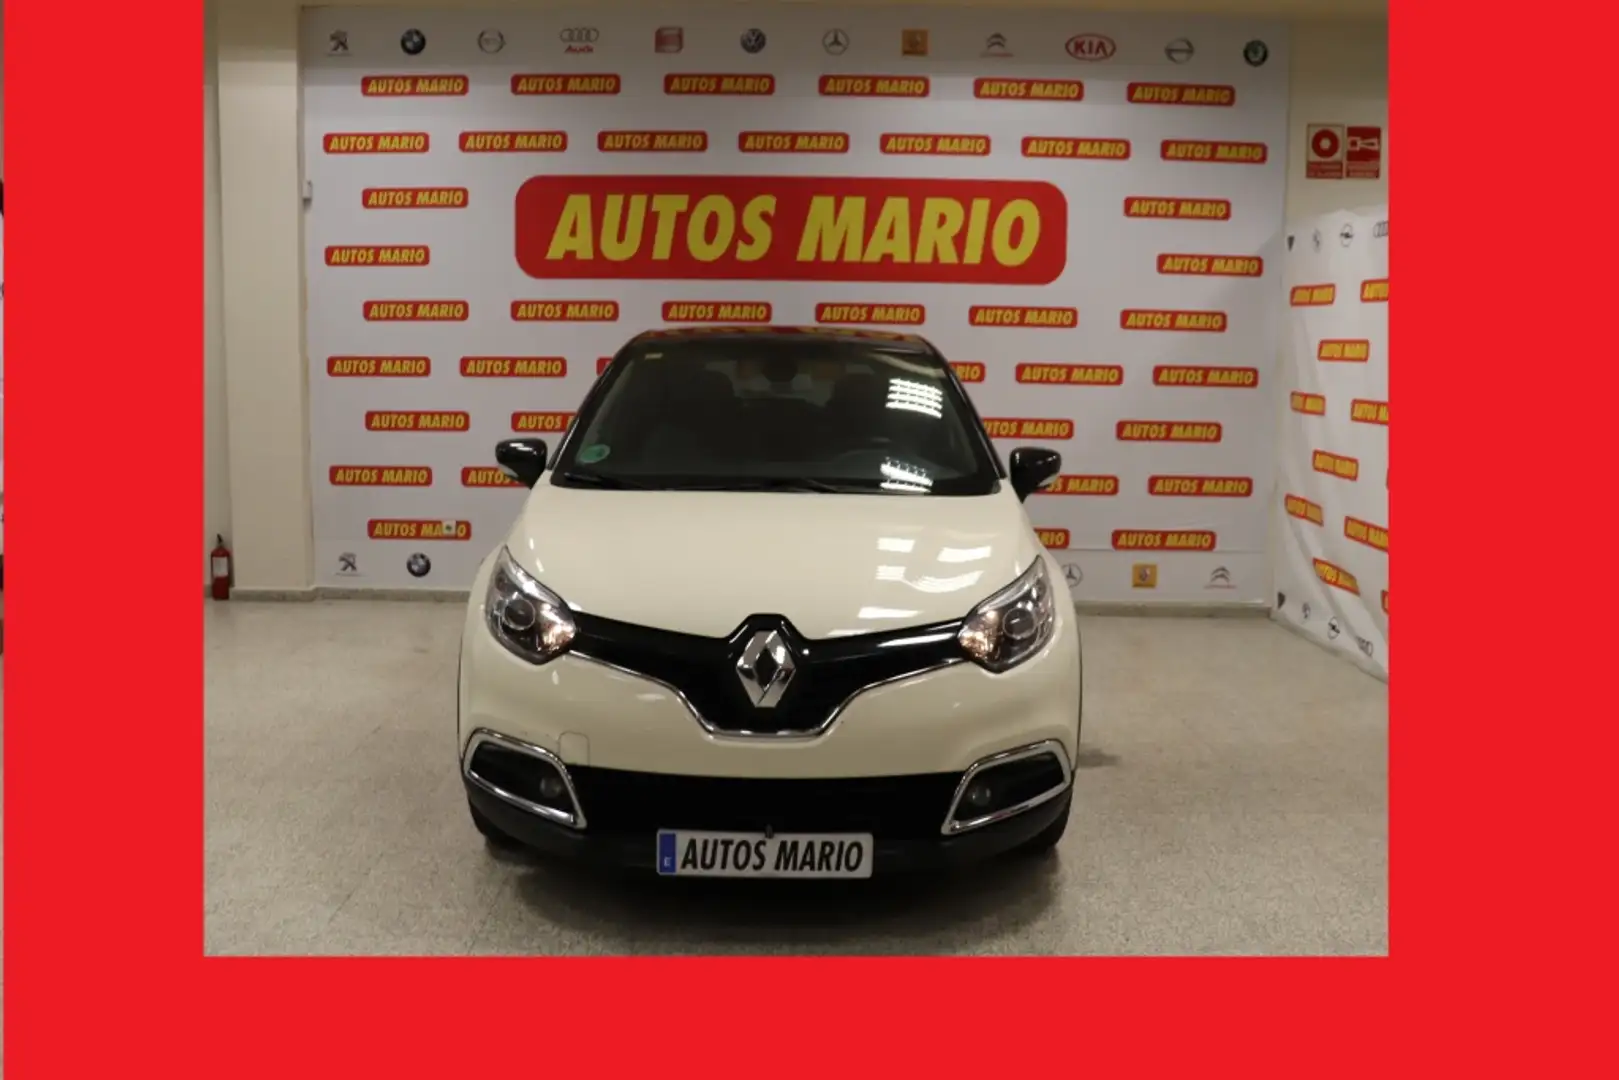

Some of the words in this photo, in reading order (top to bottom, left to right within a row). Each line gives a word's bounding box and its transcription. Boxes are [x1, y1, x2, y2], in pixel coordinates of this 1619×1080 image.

[1074, 40, 1108, 56] KIA
[368, 79, 412, 94] AUTOS
[416, 78, 463, 94] MARIO
[518, 77, 562, 91] AUTOS
[568, 77, 614, 91] MARIO
[671, 77, 715, 91] AUTOS
[722, 77, 769, 91] MARIO
[826, 78, 870, 93] AUTOS
[876, 79, 925, 94] MARIO
[980, 82, 1026, 98] AUTOS
[1030, 80, 1078, 98] MARIO
[1133, 86, 1177, 100] AUTOS
[1182, 87, 1229, 101] MARIO
[330, 136, 373, 151] AUTOS
[378, 135, 424, 151] MARIO
[466, 133, 509, 150] AUTOS
[515, 134, 562, 149] MARIO
[605, 134, 648, 148] AUTOS
[654, 134, 702, 148] MARIO
[745, 135, 790, 149] AUTOS
[796, 136, 844, 150] MARIO
[886, 137, 932, 153] AUTOS
[937, 136, 985, 153] MARIO
[1028, 140, 1073, 158] AUTOS
[1078, 139, 1125, 158] MARIO
[1168, 144, 1211, 161] AUTOS
[1216, 144, 1262, 159] MARIO
[368, 191, 412, 206] AUTOS
[417, 190, 463, 206] MARIO
[1131, 199, 1175, 218] AUTOS
[1179, 199, 1226, 218] MARIO
[546, 195, 776, 262] AUTOS
[797, 197, 1040, 267] MARIO
[332, 248, 374, 264] AUTOS
[379, 248, 424, 264] MARIO
[1163, 257, 1208, 274] AUTOS
[1212, 256, 1258, 273] MARIO
[370, 304, 412, 318] AUTOS
[417, 304, 464, 319] MARIO
[518, 304, 561, 318] AUTOS
[567, 304, 613, 318] MARIO
[669, 304, 713, 319] AUTOS
[718, 304, 766, 319] MARIO
[823, 307, 867, 323] AUTOS
[872, 307, 920, 323] MARIO
[976, 309, 1020, 326] AUTOS
[1025, 308, 1073, 325] MARIO
[1127, 312, 1170, 330] AUTOS
[1175, 312, 1222, 328] MARIO
[334, 360, 375, 374] AUTOS
[380, 360, 425, 374] MARIO
[467, 360, 510, 374] AUTOS
[515, 360, 561, 374] MARIO
[1022, 366, 1066, 383] AUTOS
[1071, 366, 1118, 382] MARIO
[1159, 369, 1203, 383] AUTOS
[1208, 368, 1253, 384] MARIO
[372, 414, 413, 428] AUTOS
[419, 414, 464, 428] MARIO
[518, 416, 562, 430] AUTOS
[1021, 422, 1069, 437] MARIO
[1123, 424, 1166, 438] AUTOS
[1171, 423, 1217, 439] MARIO
[336, 469, 377, 483] AUTOS
[382, 469, 427, 483] MARIO
[1067, 478, 1115, 492] MARIO
[1155, 479, 1197, 495] AUTOS
[1203, 480, 1248, 494] MARIO
[374, 522, 416, 536] AUTOS
[421, 523, 466, 537] MAO
[1119, 532, 1161, 546] AUTOS
[1166, 533, 1210, 547] MARIO
[680, 837, 767, 871] AUTOS
[774, 839, 863, 872] MARIO
